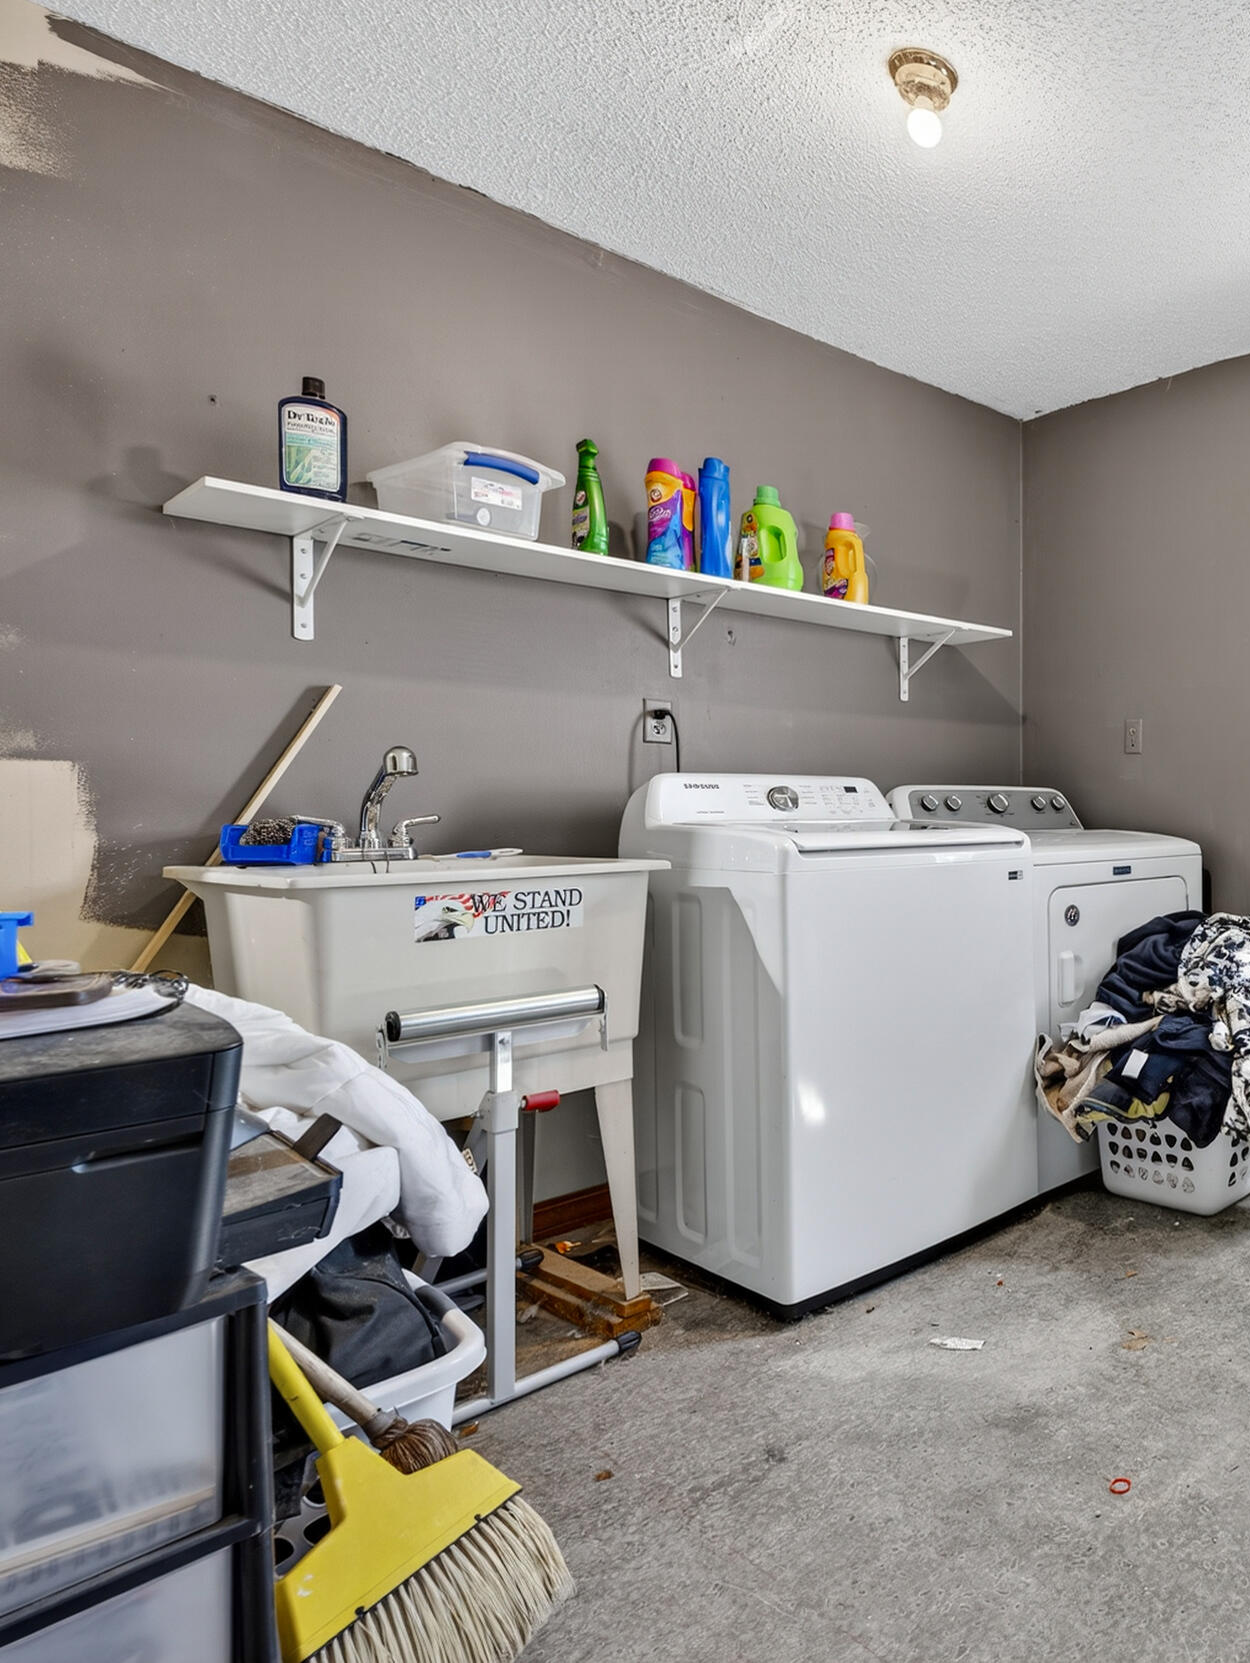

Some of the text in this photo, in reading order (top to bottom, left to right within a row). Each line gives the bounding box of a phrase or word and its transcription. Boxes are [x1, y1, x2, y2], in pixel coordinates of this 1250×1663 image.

[471, 888, 582, 913] WE STAND
[484, 910, 571, 935] UNITED!
